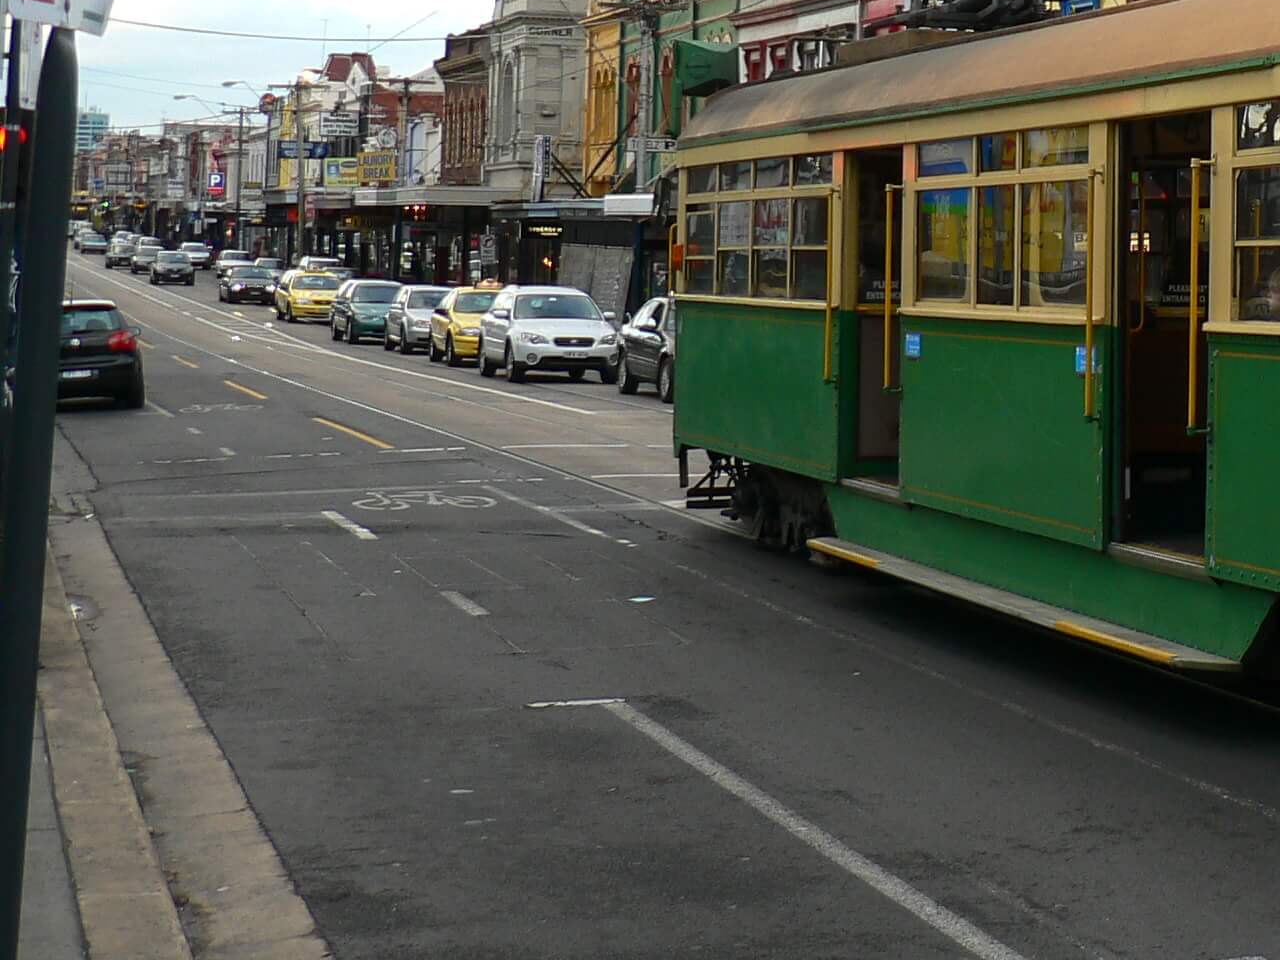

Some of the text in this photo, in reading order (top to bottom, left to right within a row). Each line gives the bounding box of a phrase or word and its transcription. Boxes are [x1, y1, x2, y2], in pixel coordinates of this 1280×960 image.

[528, 25, 573, 37] CORNER
[364, 167, 389, 178] BREAK
[210, 174, 220, 186] P
